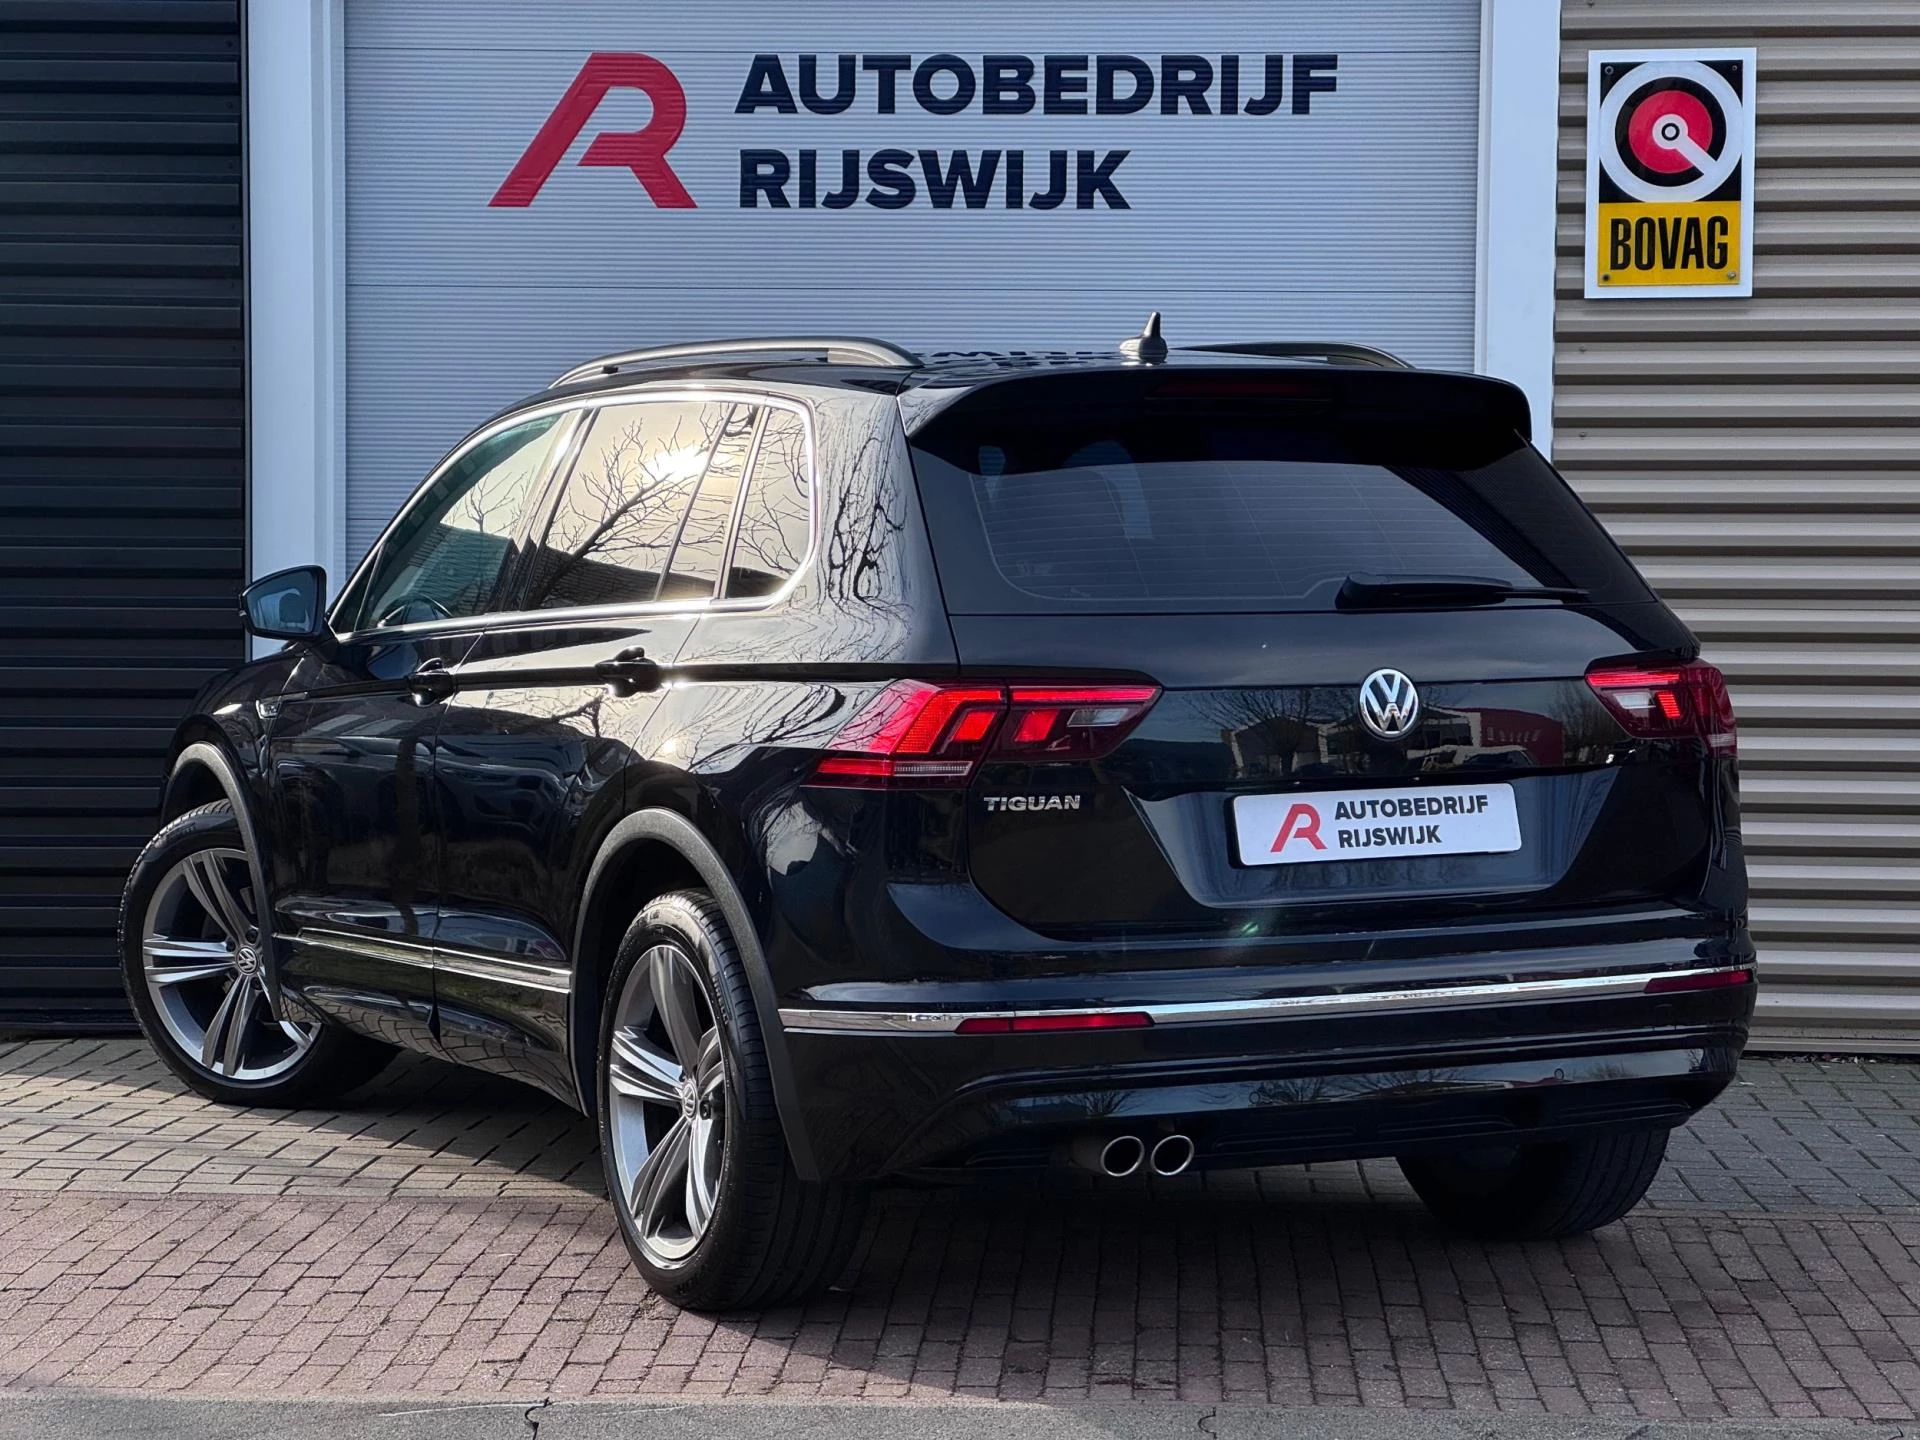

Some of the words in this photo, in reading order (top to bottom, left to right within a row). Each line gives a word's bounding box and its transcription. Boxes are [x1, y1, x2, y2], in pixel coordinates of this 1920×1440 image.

[735, 54, 1338, 116] AUTOBEDRIJF
[739, 149, 1131, 210] RIJSWIJK
[1610, 215, 1729, 271] BOVAG
[983, 794, 1081, 812] TIGUAN
[1334, 794, 1489, 821] AUTOBEDRIJF
[1338, 824, 1443, 849] RIJSWIJK
